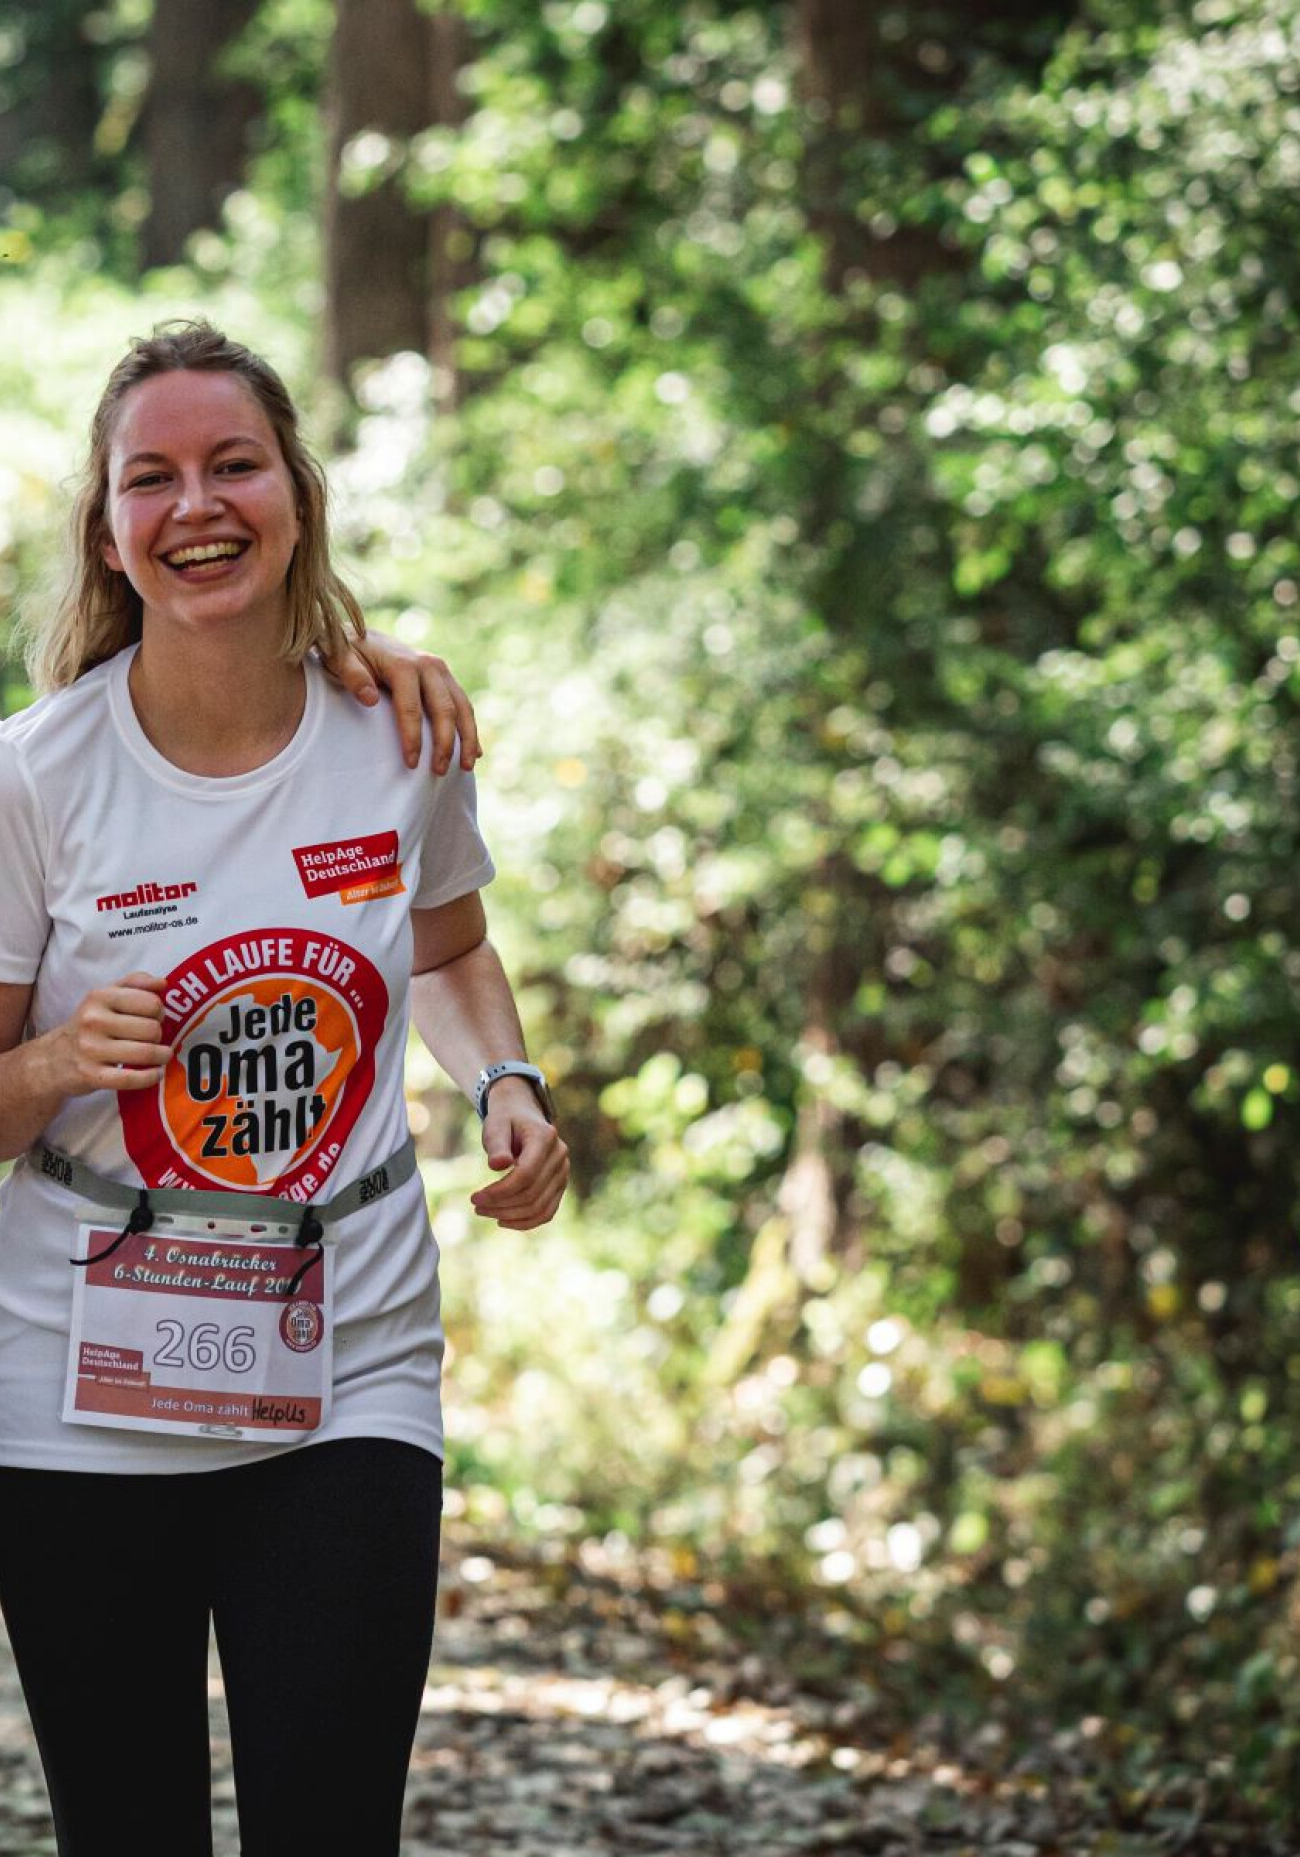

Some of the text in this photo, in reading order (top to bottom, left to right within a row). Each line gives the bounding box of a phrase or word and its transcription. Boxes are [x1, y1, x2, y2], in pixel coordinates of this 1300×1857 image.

[300, 845, 364, 867] HelpAge
[306, 850, 396, 882] Deutschland
[96, 882, 197, 912] molitor
[123, 904, 178, 920] Laufanalyse
[108, 916, 198, 938] www.molitor-os.de
[164, 971, 209, 1022] ICH
[204, 938, 294, 985] LAUFE
[218, 994, 317, 1044] Jede
[187, 1040, 315, 1101] Oma
[202, 1093, 327, 1157] zählt
[145, 1243, 277, 1271] 4. Osnabrücker
[114, 1262, 259, 1297] 6-Stunden-Lauf
[153, 1319, 257, 1374] 266
[152, 1397, 180, 1411] Jede
[184, 1400, 213, 1414] Oma
[252, 1397, 305, 1426] HelpUs
